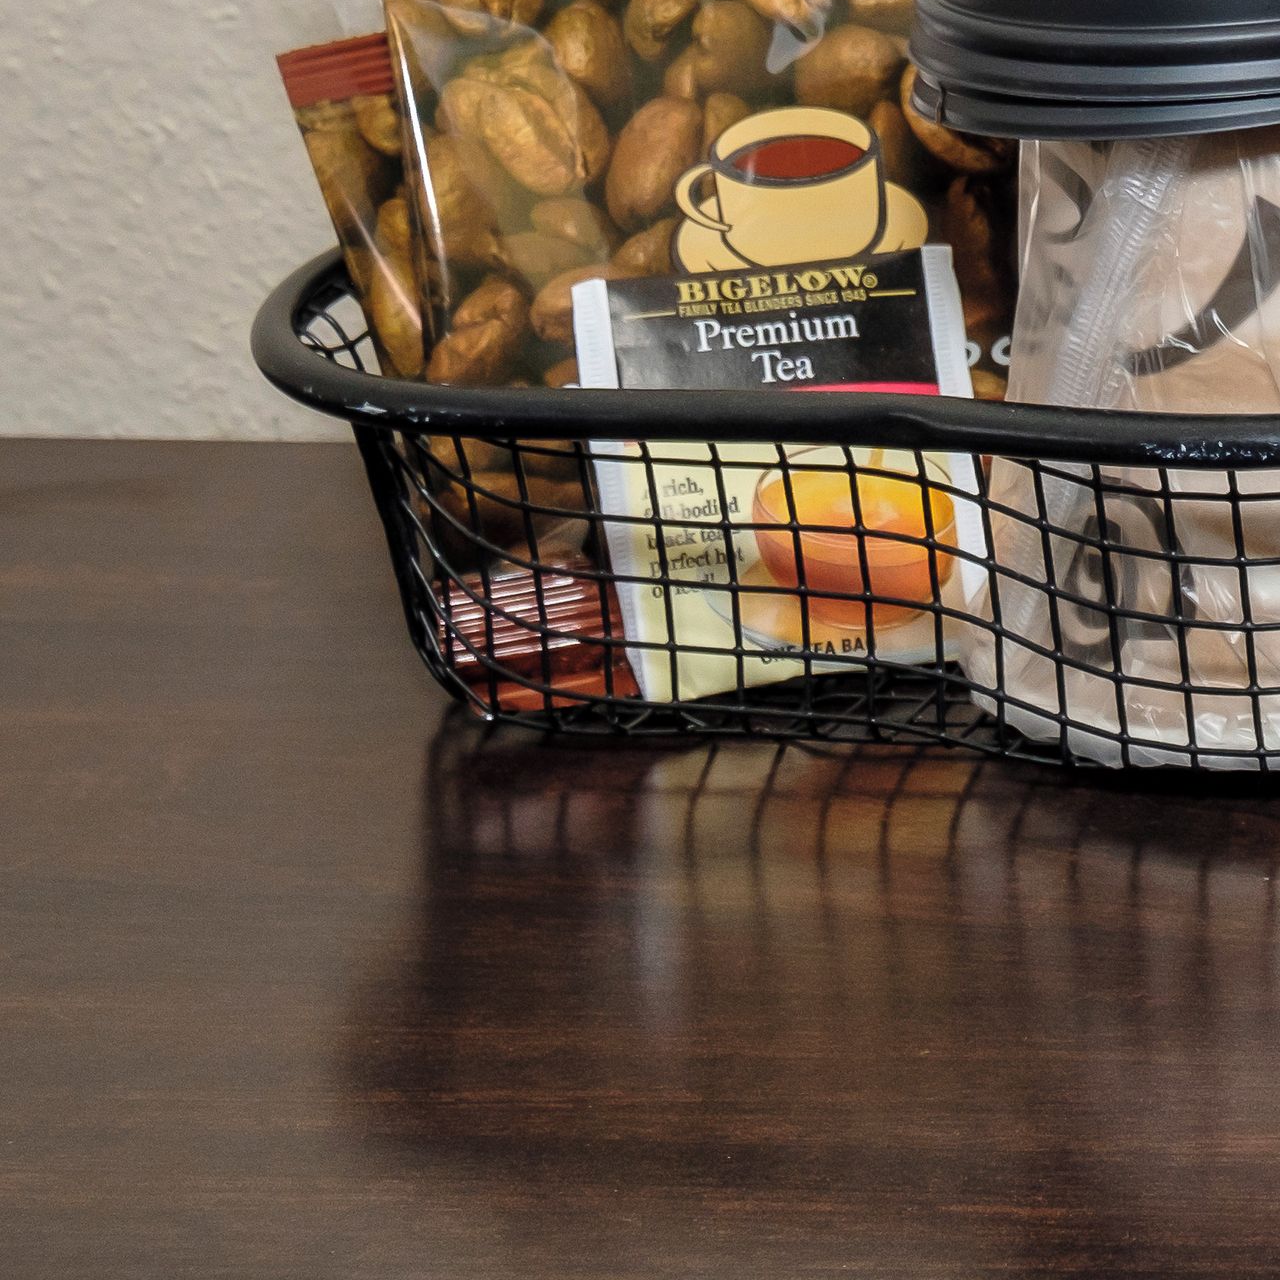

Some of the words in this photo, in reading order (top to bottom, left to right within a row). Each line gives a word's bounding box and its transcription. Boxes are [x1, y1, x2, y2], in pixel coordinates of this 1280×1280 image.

[676, 266, 867, 303] BIGELOW
[693, 311, 861, 353] Premium
[750, 350, 816, 384] Tea
[650, 551, 712, 578] prfect
[714, 547, 744, 566] ht
